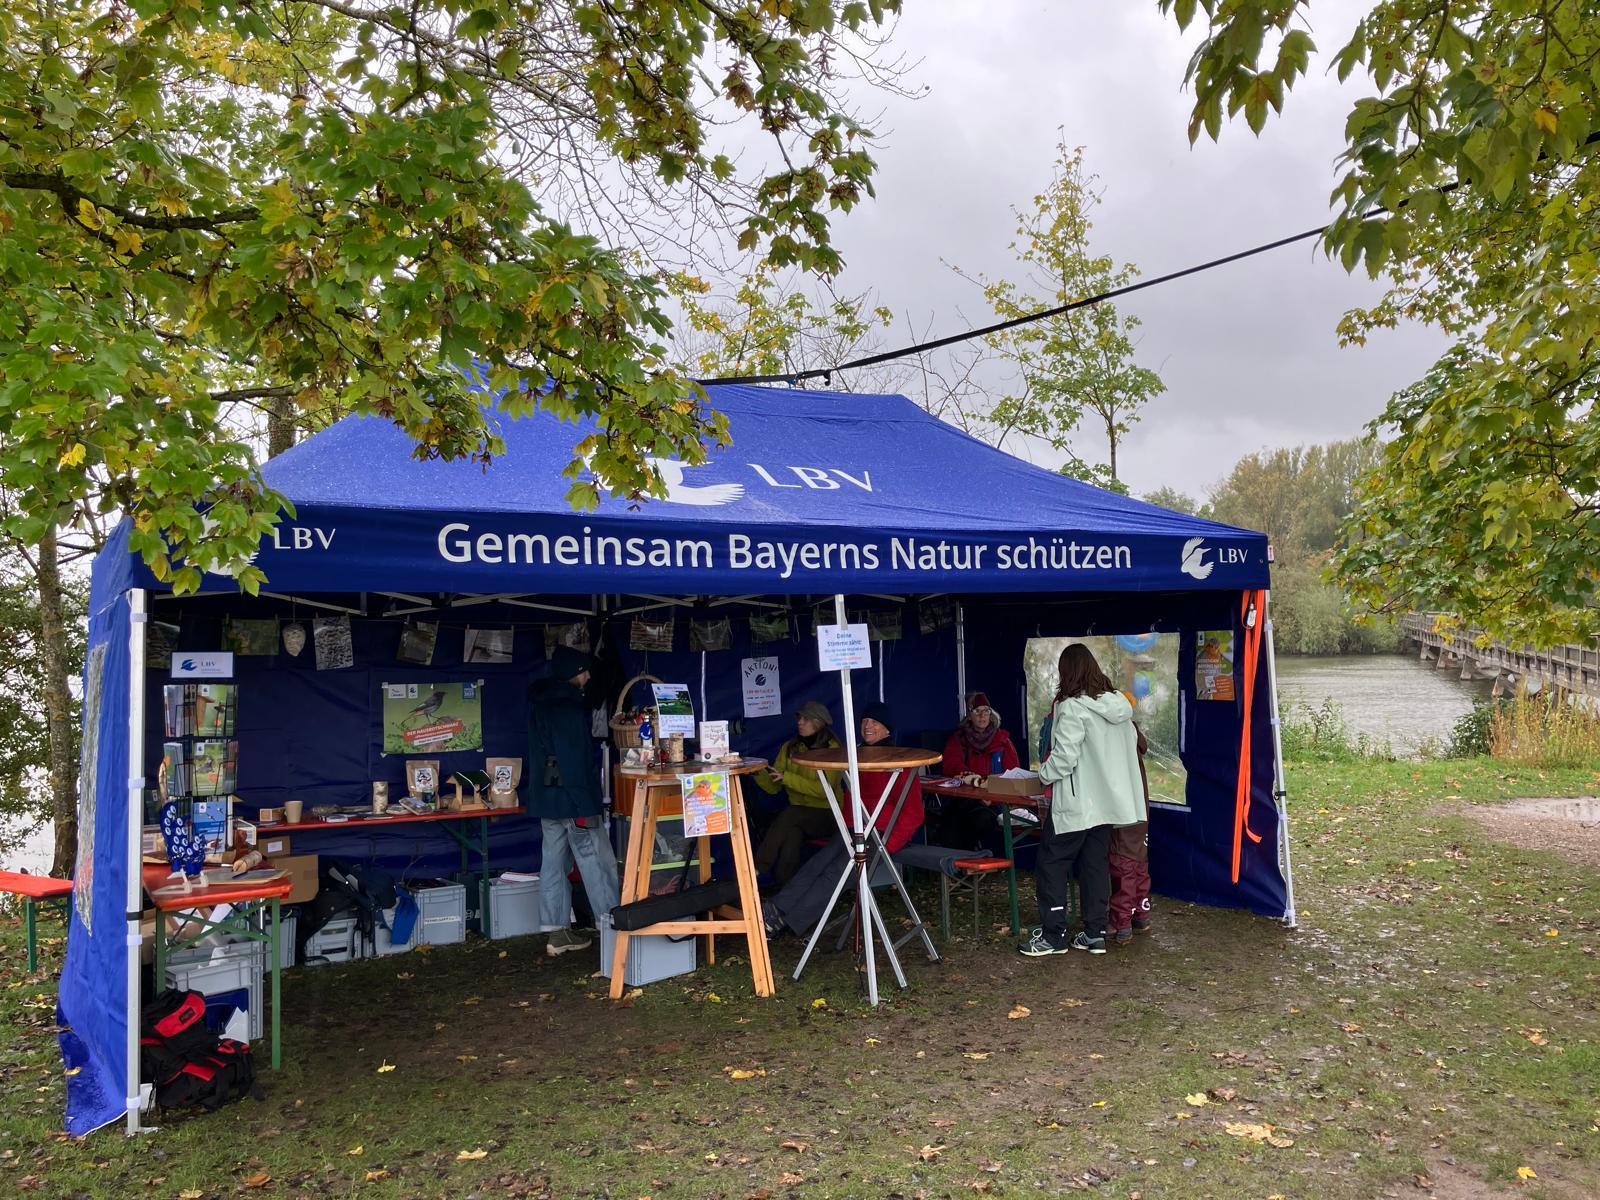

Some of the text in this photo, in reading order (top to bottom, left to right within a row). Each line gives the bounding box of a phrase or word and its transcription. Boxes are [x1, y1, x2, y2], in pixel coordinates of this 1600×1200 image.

[747, 463, 874, 492] LBV
[273, 527, 336, 550] LBV
[437, 522, 1133, 579] Gemeinsam Bayerns Natur schützen
[1218, 548, 1249, 564] LBV
